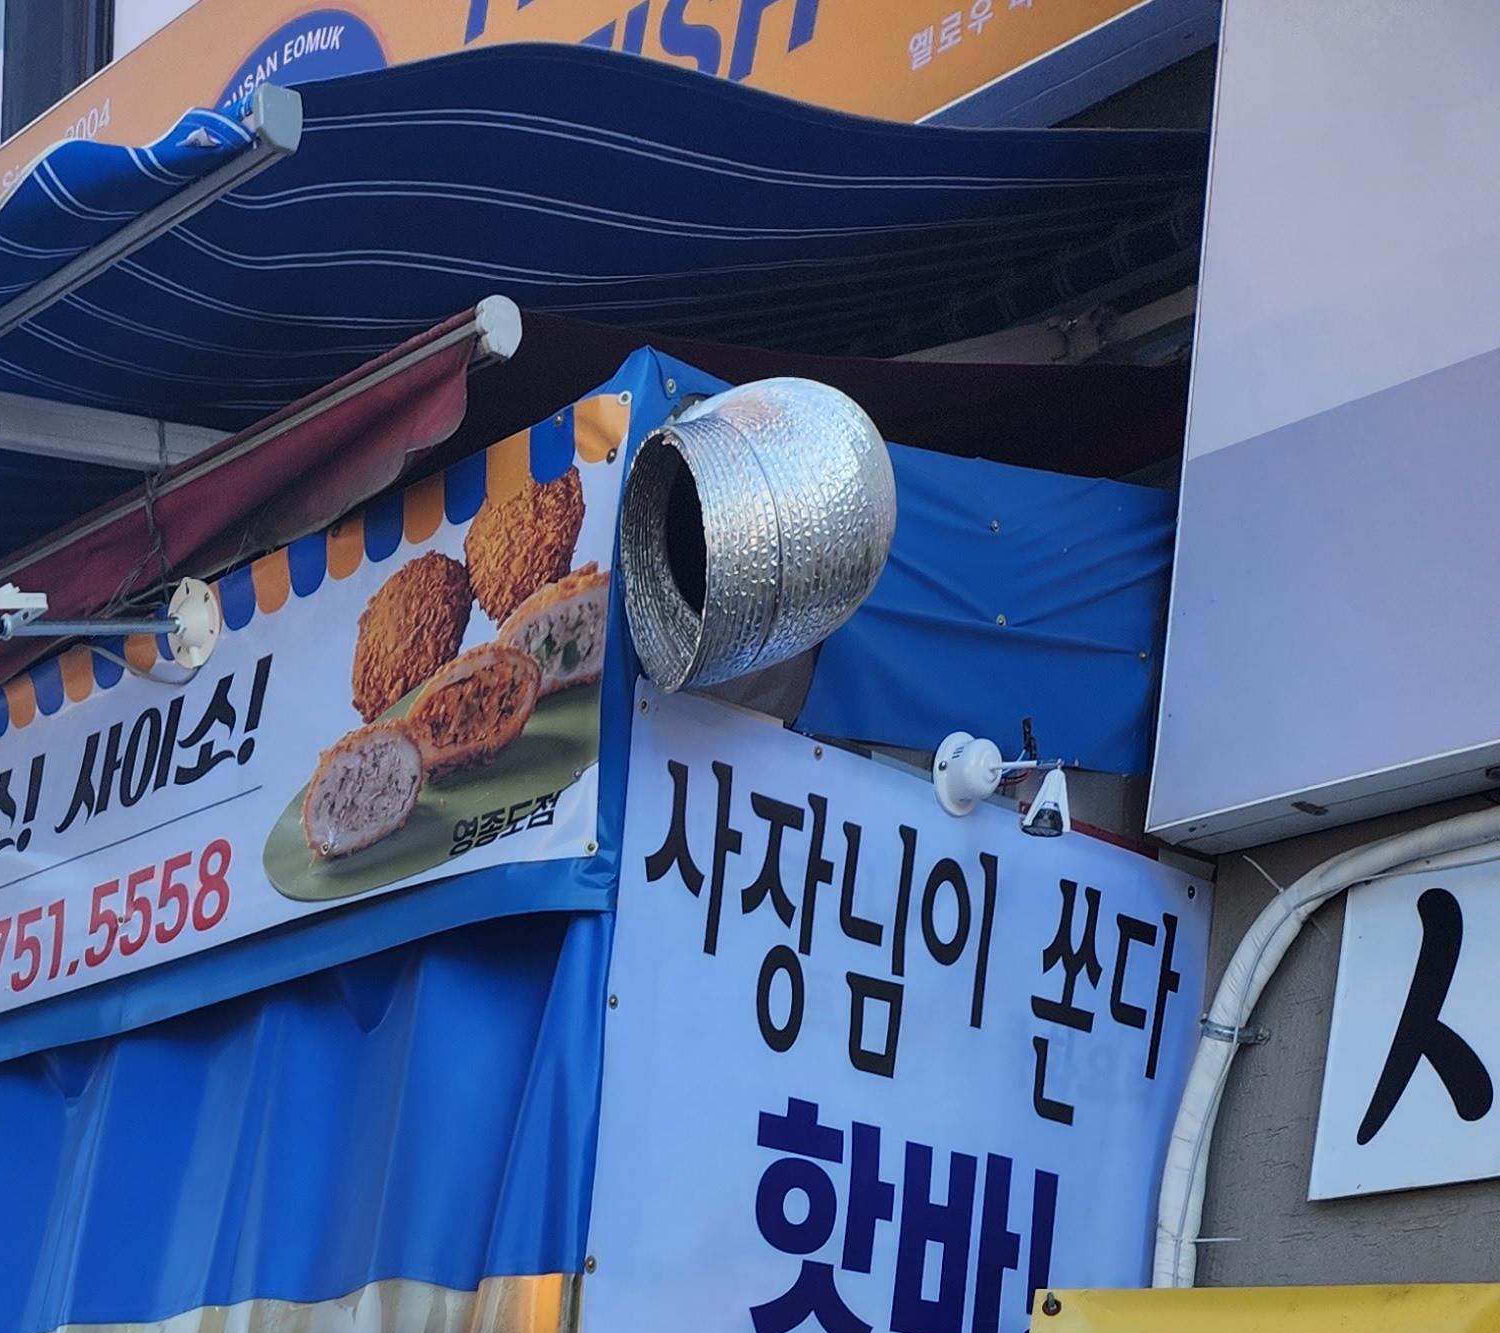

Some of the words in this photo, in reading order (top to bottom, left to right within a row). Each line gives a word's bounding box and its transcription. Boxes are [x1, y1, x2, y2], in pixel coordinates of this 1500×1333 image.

[283, 25, 345, 65] EOMUK
[55, 654, 274, 832] 사이소!
[449, 790, 560, 856] 영종도점
[644, 758, 998, 1079] 사장님이
[1030, 877, 1180, 1126] 쏜다
